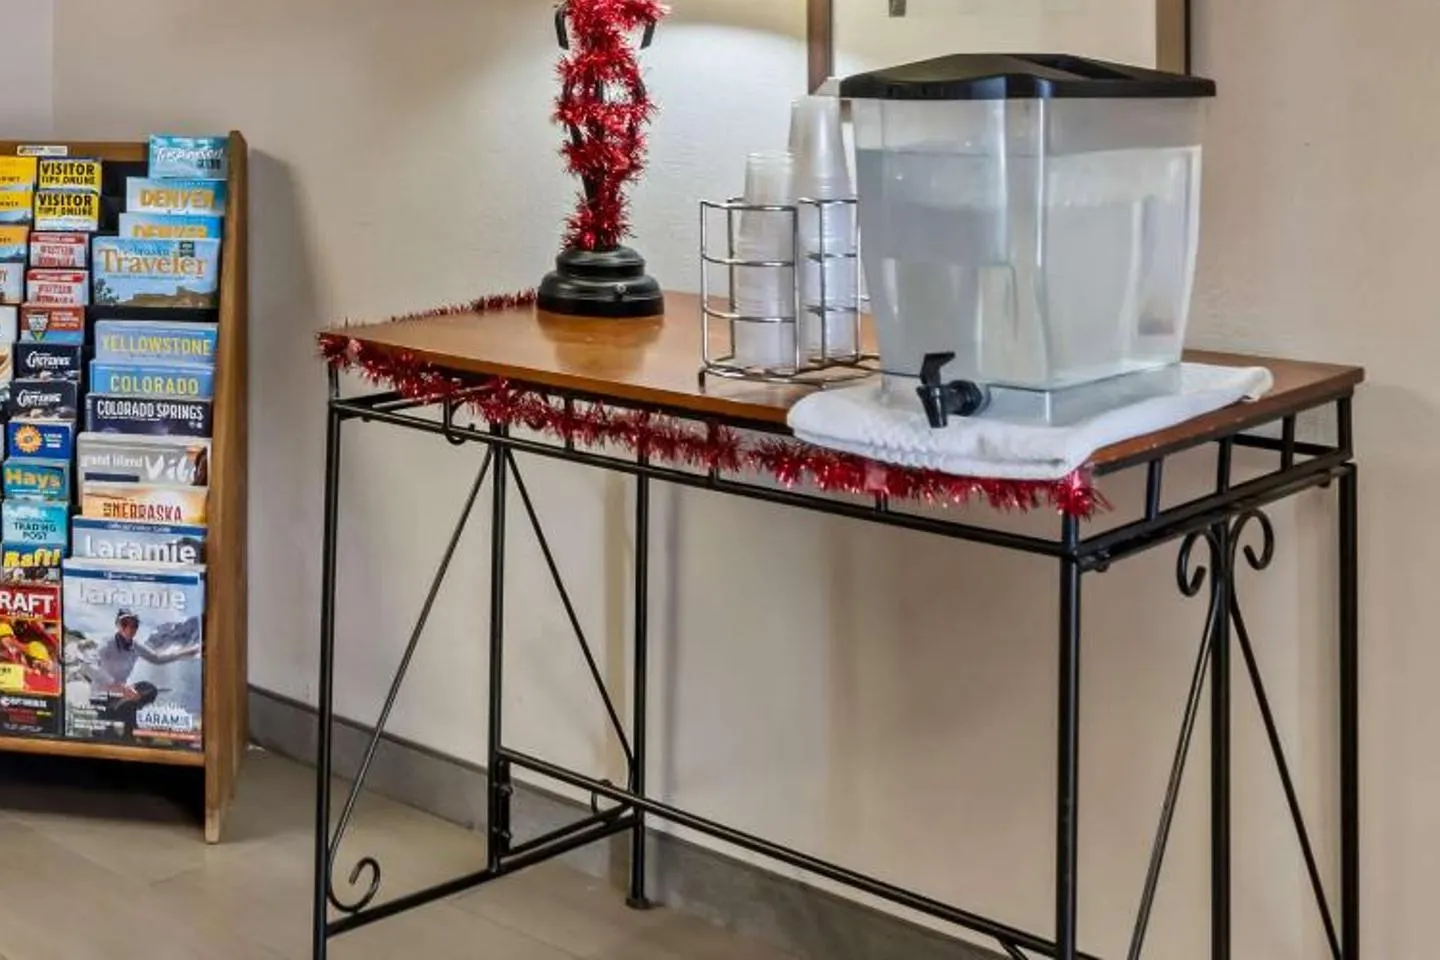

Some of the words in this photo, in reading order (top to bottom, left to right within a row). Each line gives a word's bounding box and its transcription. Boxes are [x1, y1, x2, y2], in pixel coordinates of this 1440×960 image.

[41, 163, 95, 176] VISITOR
[41, 176, 60, 184] TIPS
[63, 176, 95, 185] ONLINE
[38, 193, 92, 206] VISITOR
[139, 188, 214, 209] DENVER
[38, 206, 58, 215] TIPS
[61, 207, 93, 216] ONLINE
[99, 248, 206, 275] Traveler
[102, 336, 212, 356] YELLOWSTONE
[110, 376, 199, 395] COLORADO
[97, 400, 154, 418] COLORADO
[155, 402, 204, 421] SPRINGS
[5, 468, 61, 489] Hays
[113, 502, 183, 522] NEBRASKA
[13, 521, 57, 532] TRADING
[22, 530, 48, 541] POST
